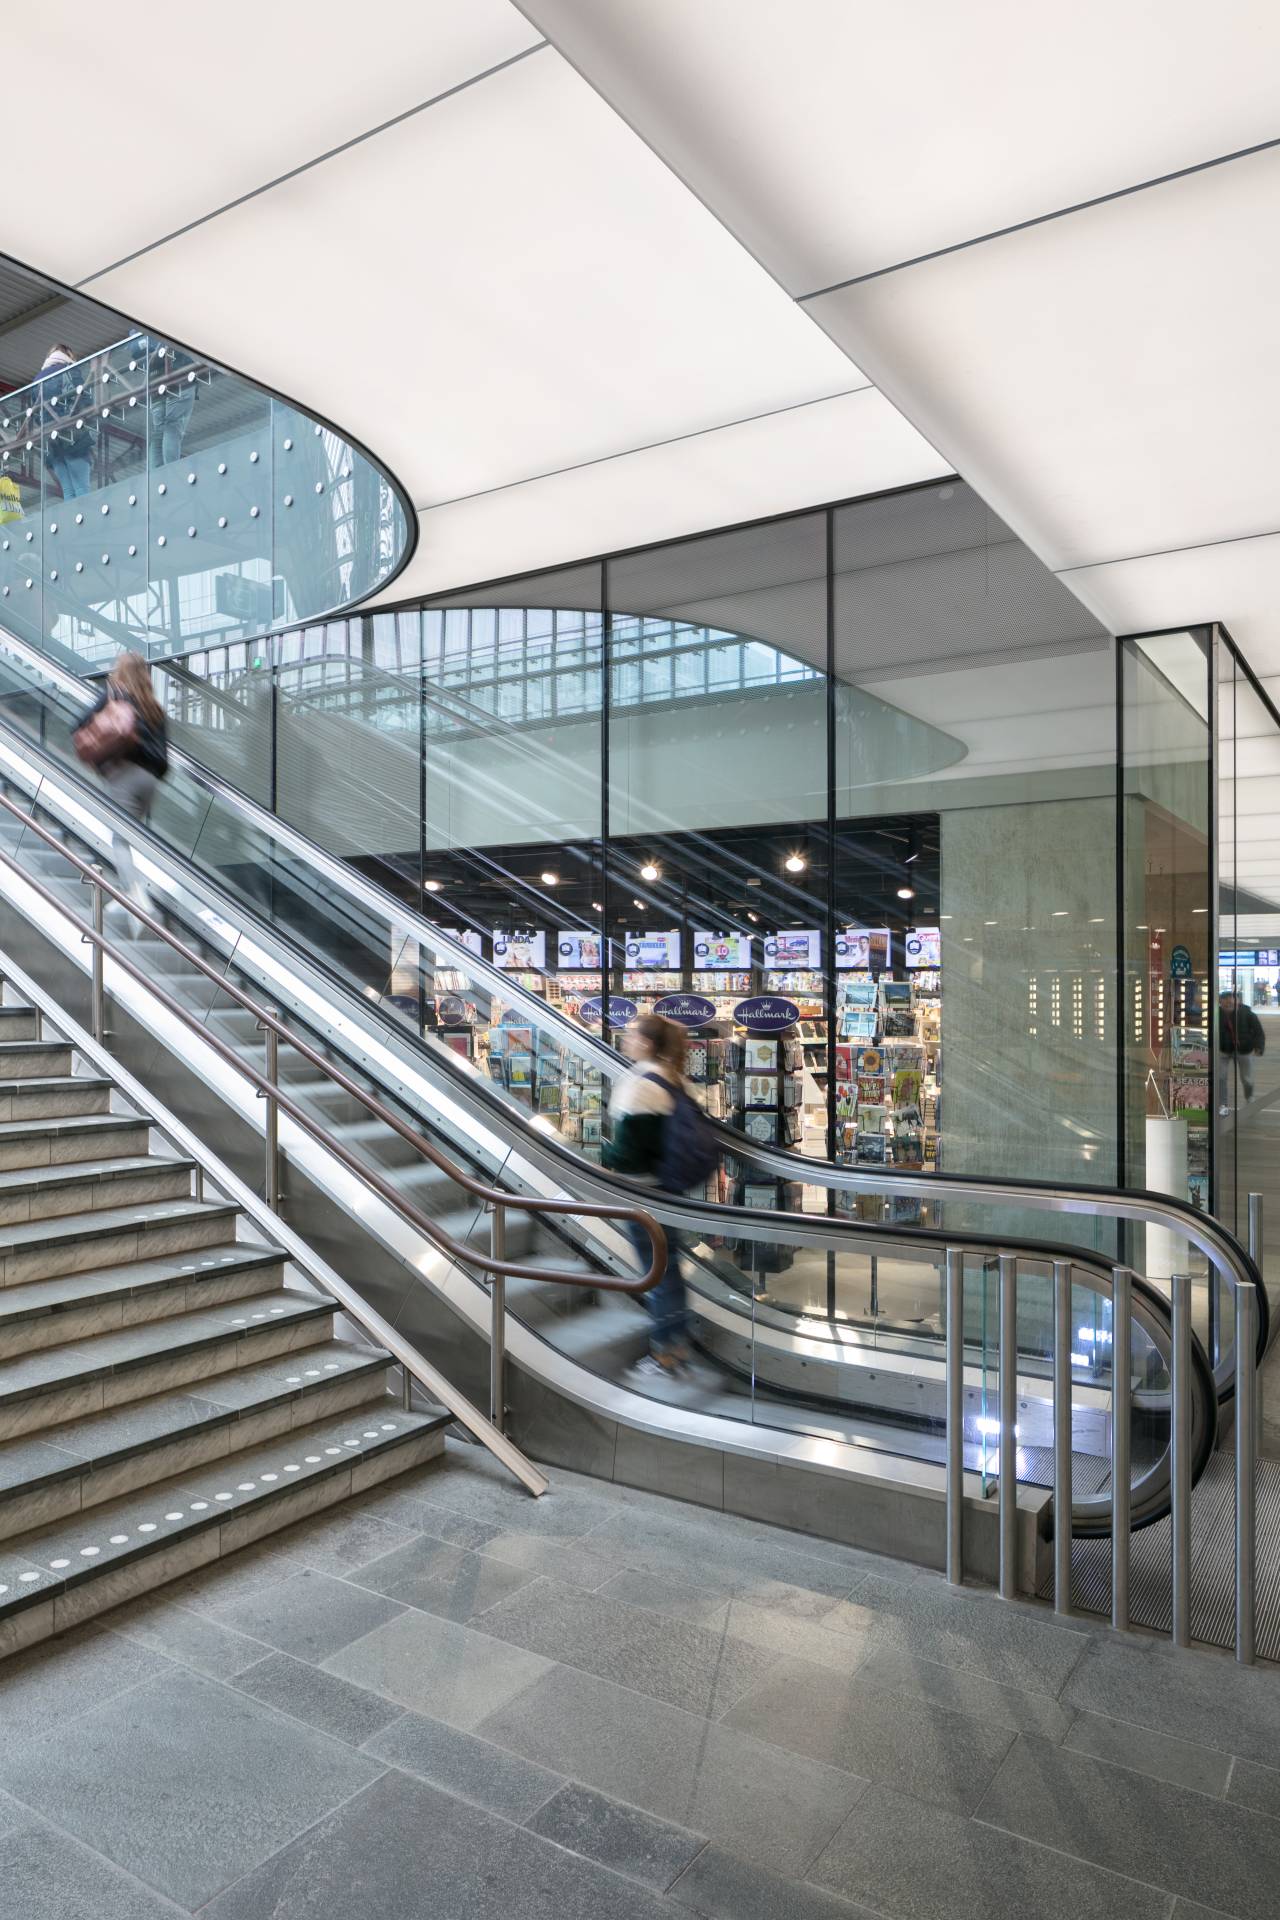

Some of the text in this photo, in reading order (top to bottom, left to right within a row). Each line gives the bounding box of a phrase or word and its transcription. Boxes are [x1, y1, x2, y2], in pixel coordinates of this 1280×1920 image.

[503, 935, 534, 944] LINDA.
[583, 1006, 635, 1020] Halmark
[656, 1004, 713, 1019] Hallmark
[737, 1007, 796, 1024] Hallmark
